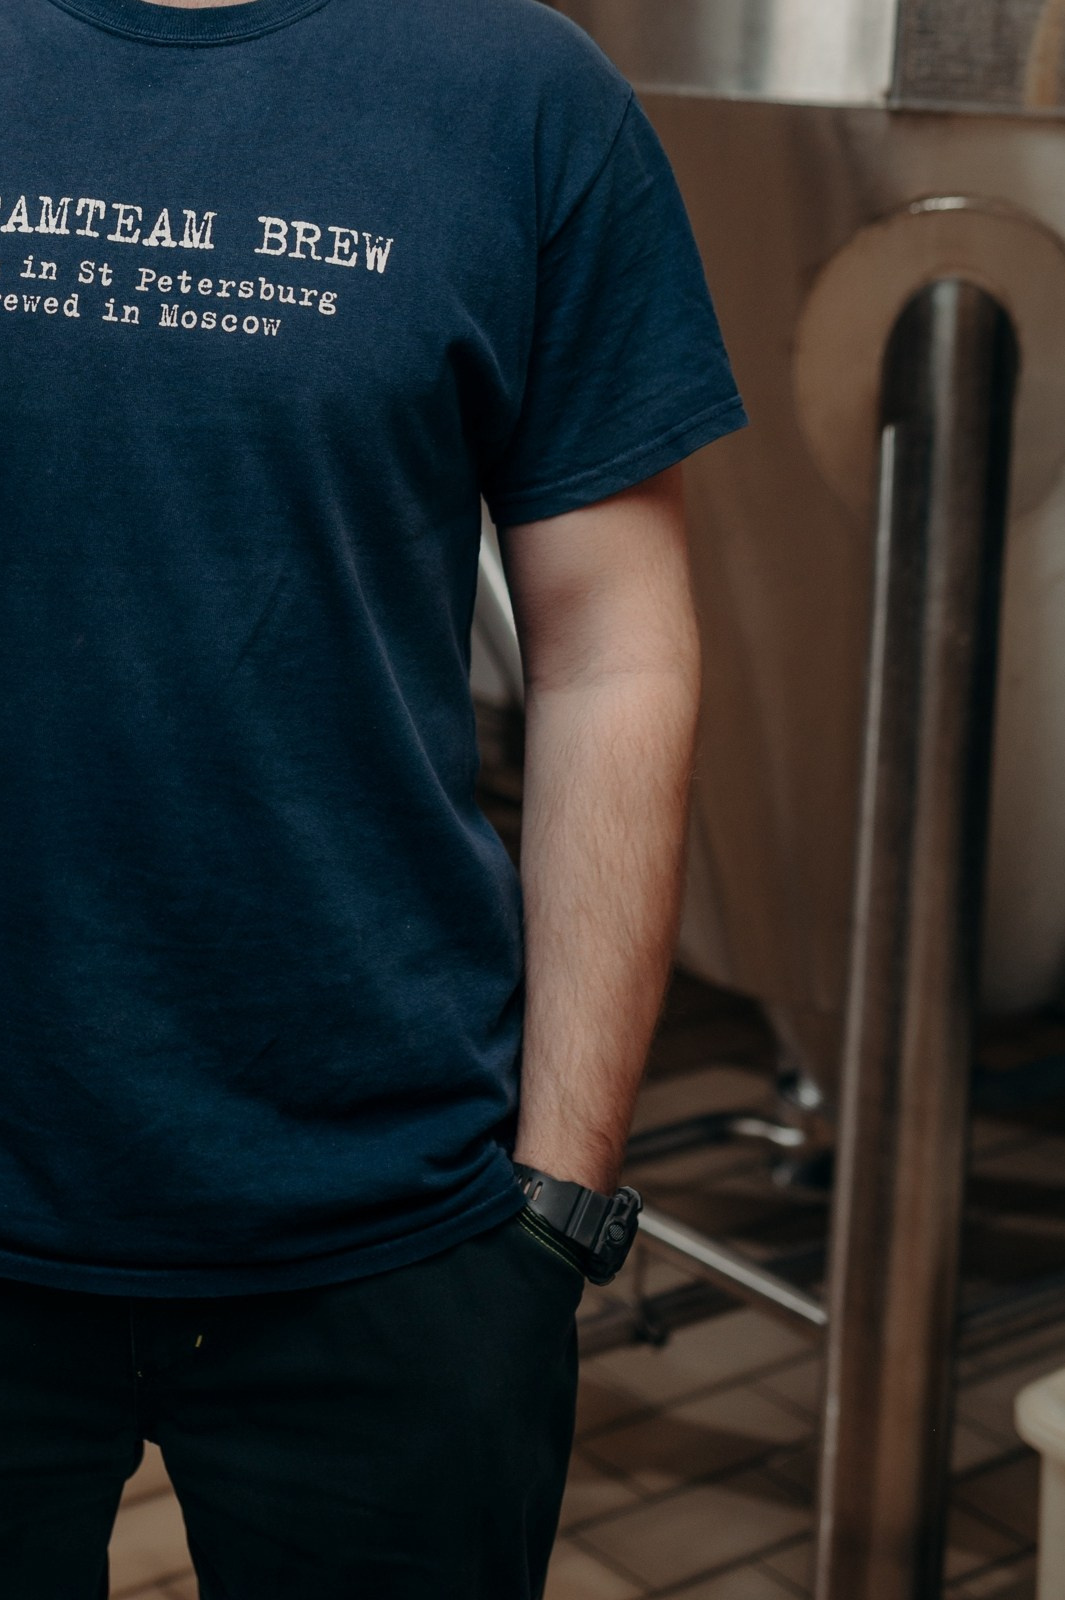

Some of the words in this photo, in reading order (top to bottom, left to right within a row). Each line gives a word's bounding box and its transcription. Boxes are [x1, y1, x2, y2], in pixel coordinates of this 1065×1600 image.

[253, 215, 395, 274] BREW
[19, 254, 57, 281] in
[77, 260, 114, 288] St
[134, 267, 338, 316] Petersburg
[101, 296, 141, 325] in
[158, 303, 283, 338] Moscow
